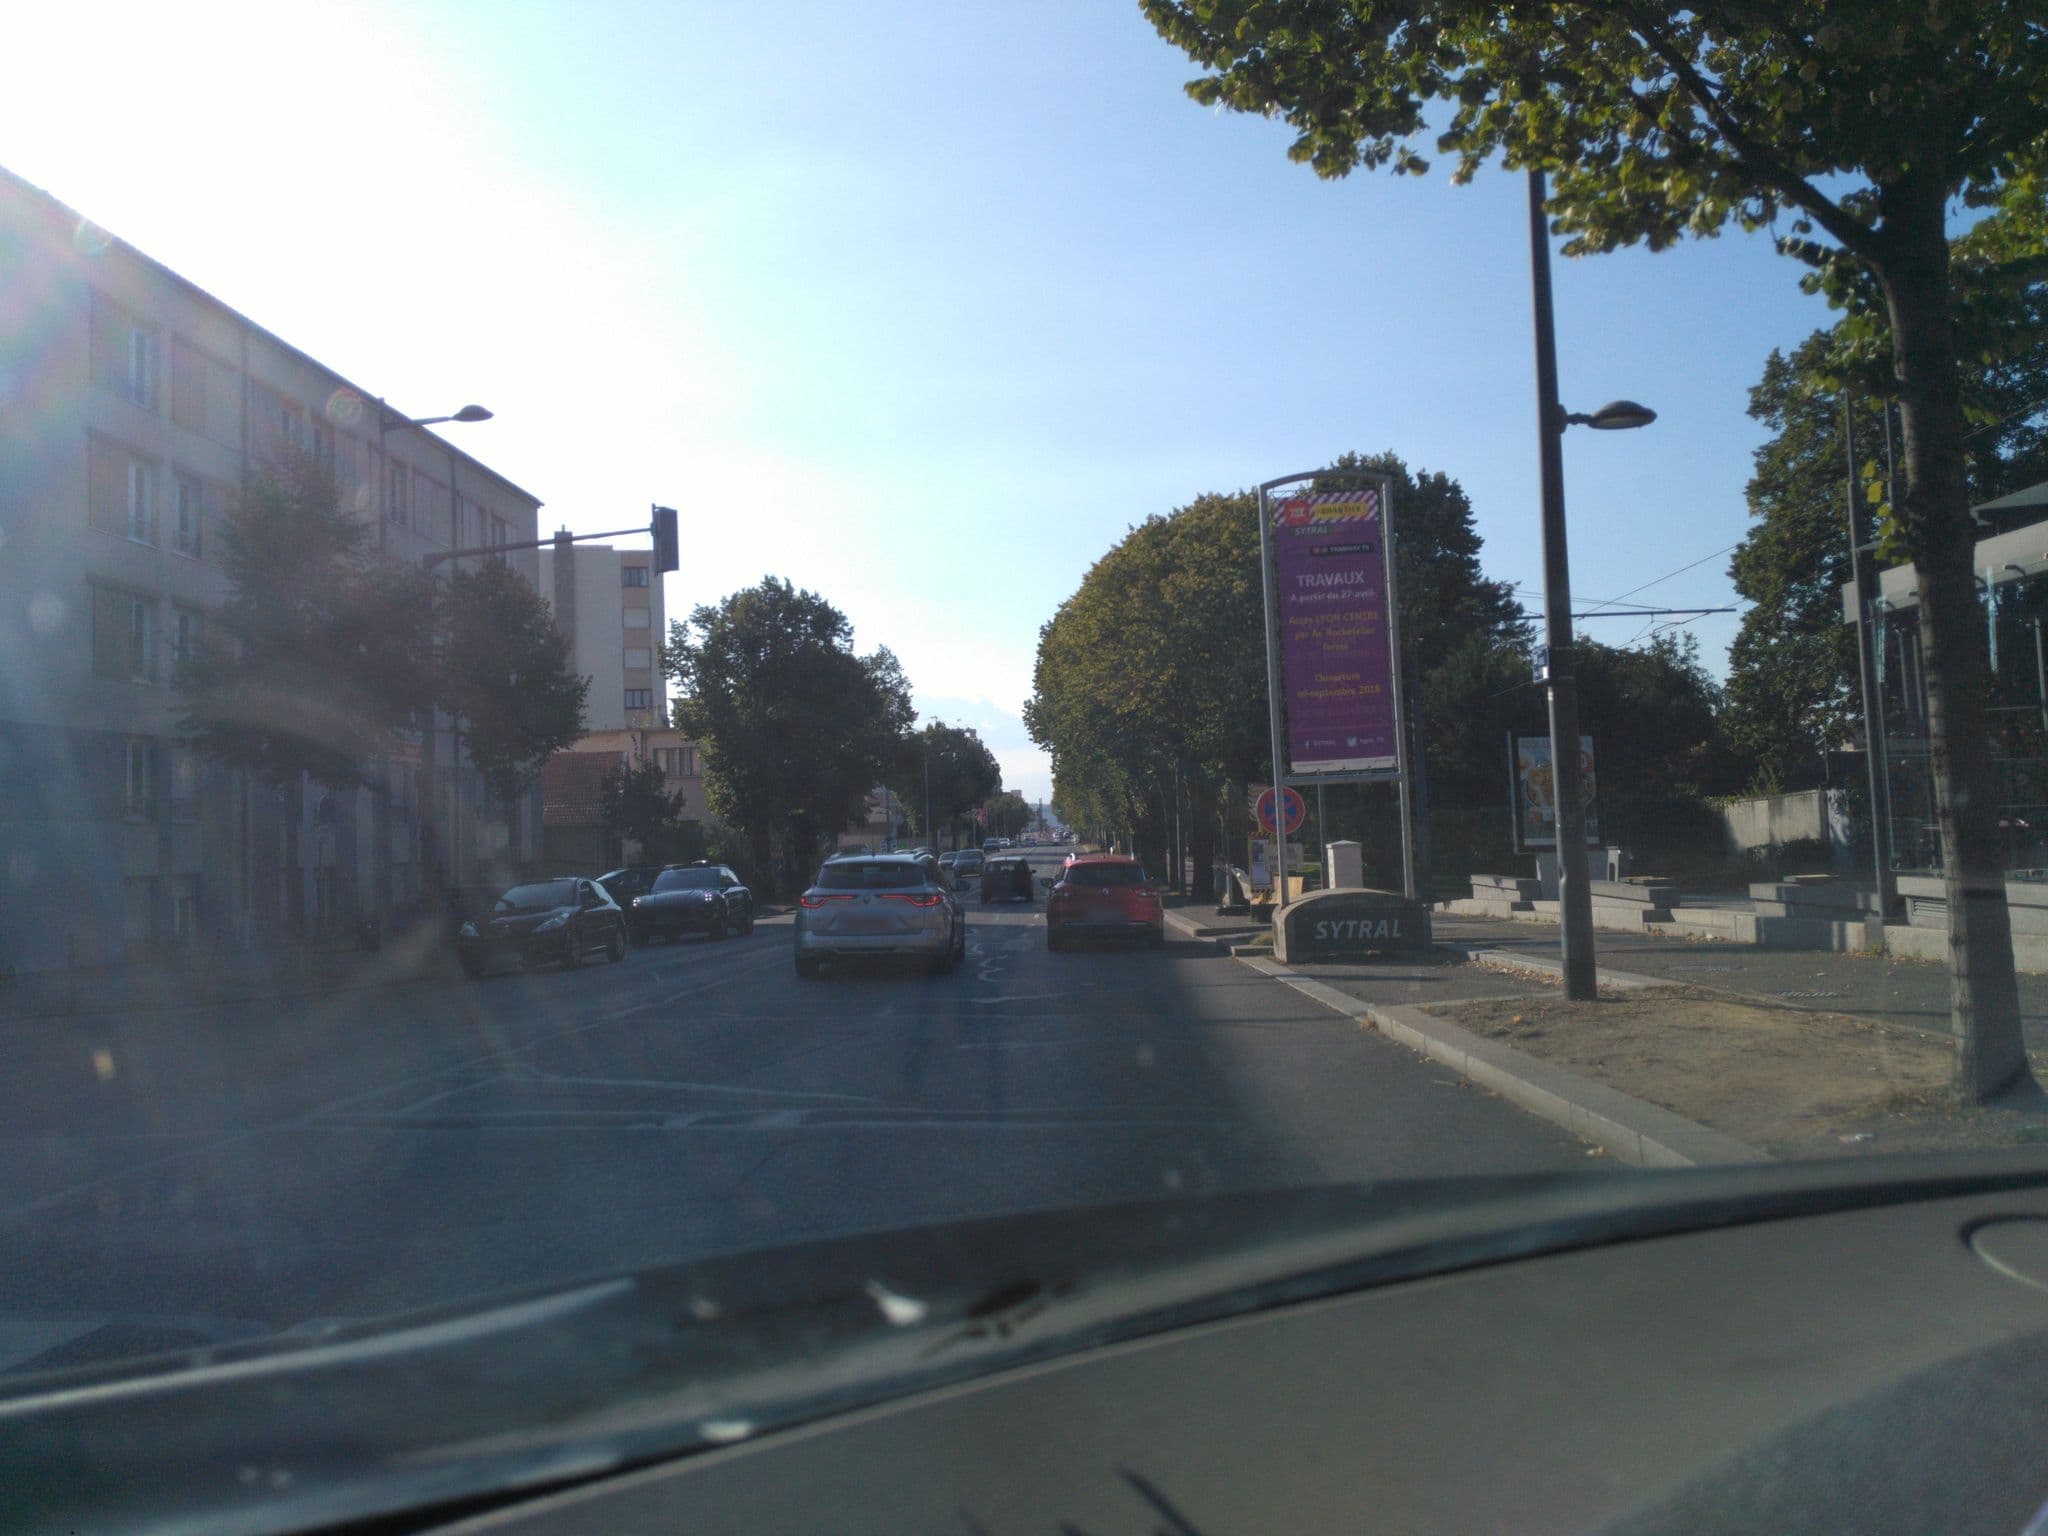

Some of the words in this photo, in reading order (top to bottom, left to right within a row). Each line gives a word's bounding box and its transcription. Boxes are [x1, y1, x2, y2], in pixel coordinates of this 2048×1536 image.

[1295, 526, 1328, 536] SYTRAL
[1296, 570, 1364, 587] TRAVAUX
[1313, 918, 1403, 941] SYTRAL
